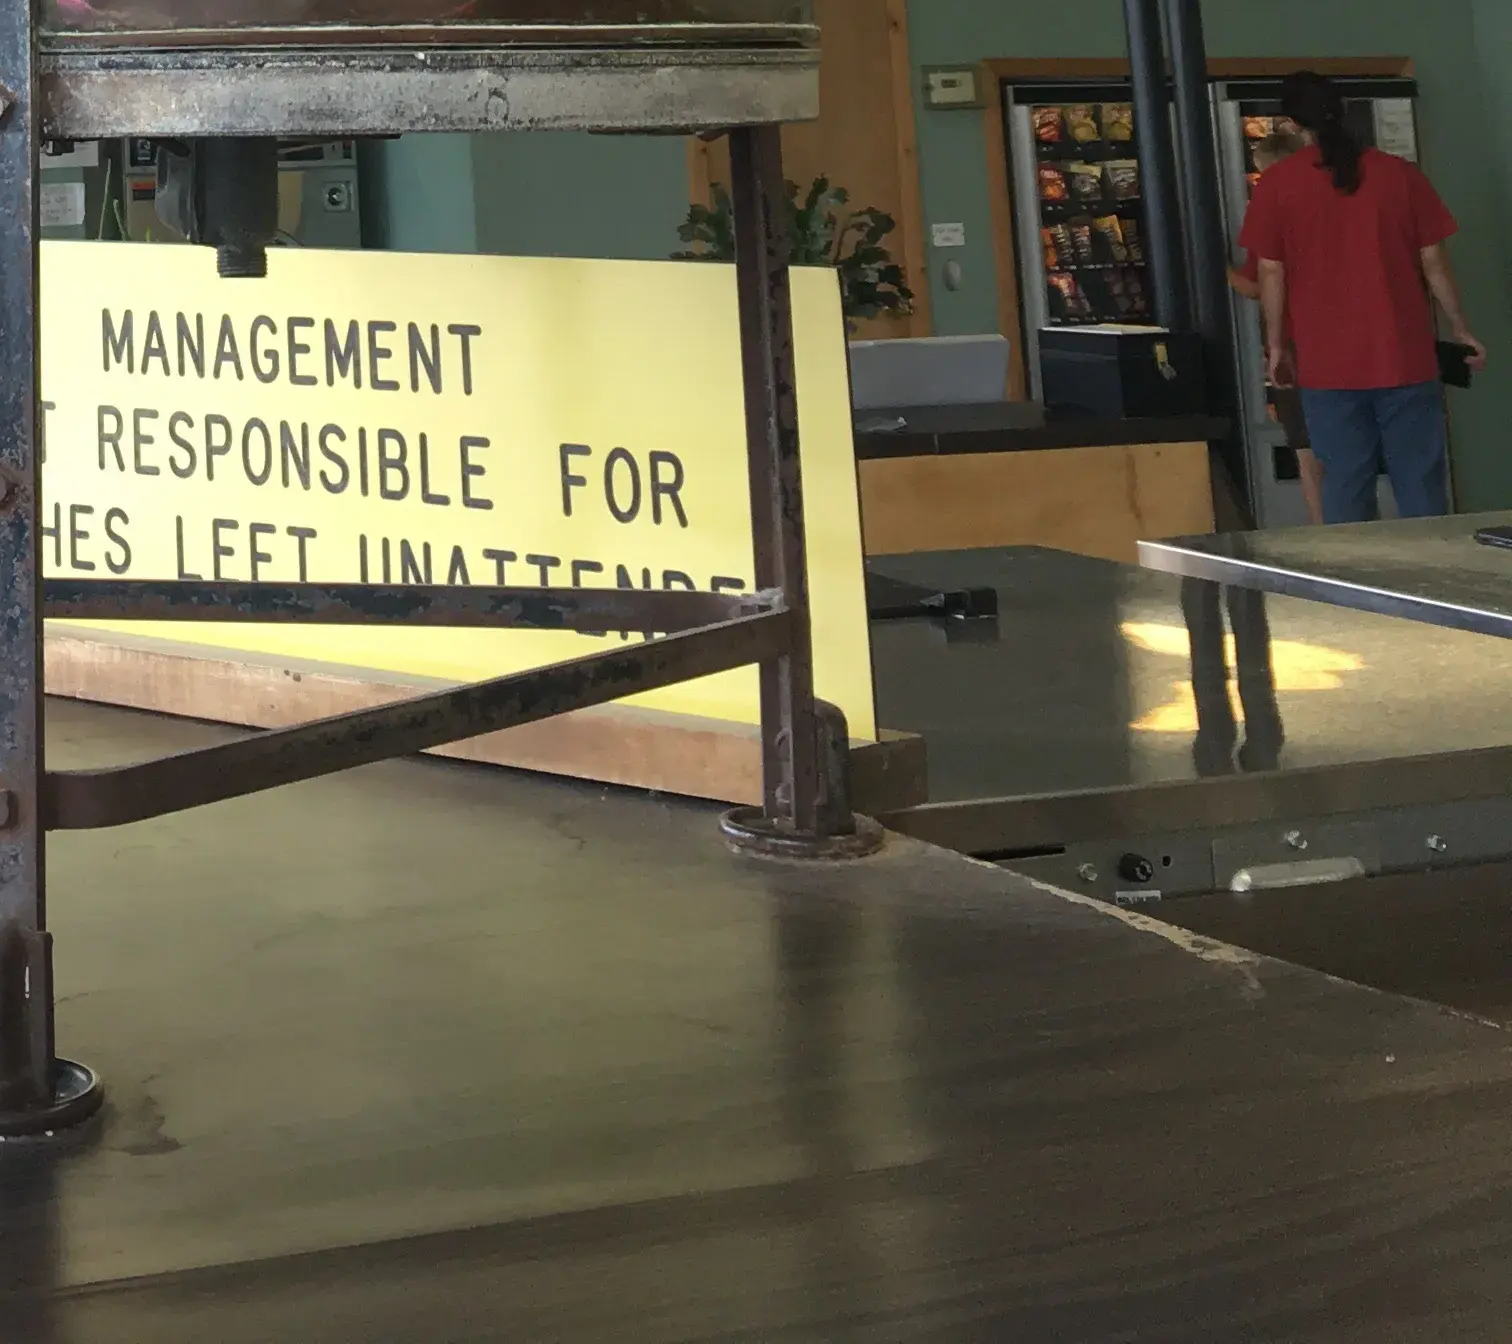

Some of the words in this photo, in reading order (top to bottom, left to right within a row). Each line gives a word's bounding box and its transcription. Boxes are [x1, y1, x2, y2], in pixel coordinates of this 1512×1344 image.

[102, 308, 482, 396] MANAGEMENT
[97, 405, 494, 510] RESPONSIBLE
[559, 443, 689, 529] FOR
[175, 515, 318, 582] LEFT
